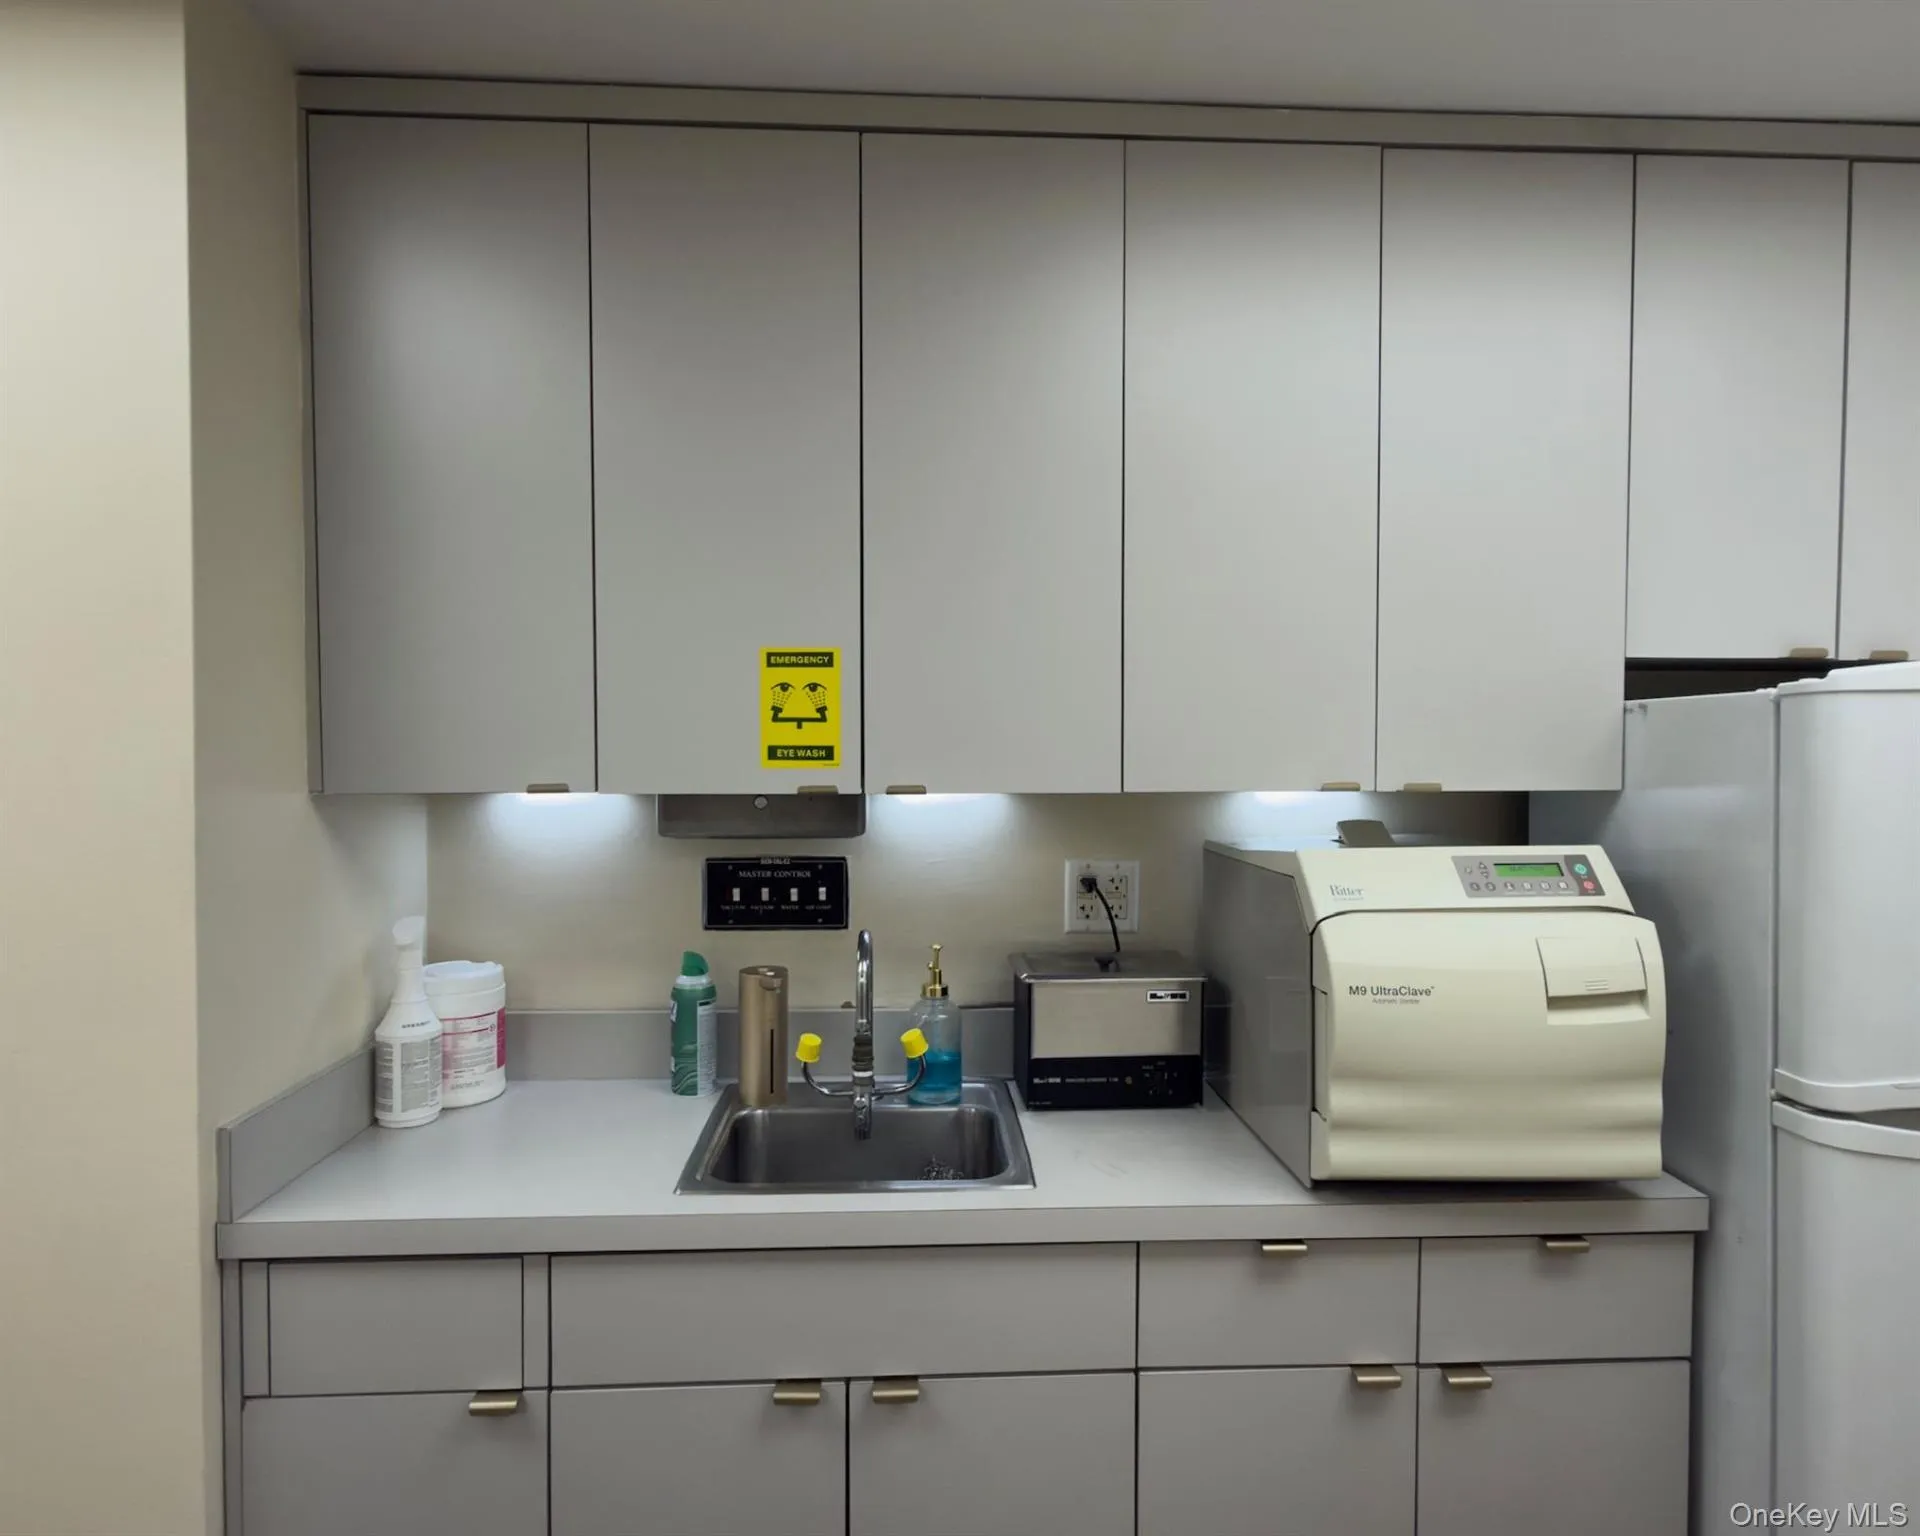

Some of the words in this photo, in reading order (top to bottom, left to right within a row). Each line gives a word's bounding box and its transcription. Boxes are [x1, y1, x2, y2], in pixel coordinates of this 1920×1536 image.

[770, 655, 830, 664] EMERGENCY
[776, 749, 795, 757] EYE
[797, 749, 826, 757] WASH
[739, 870, 772, 878] MASTER
[773, 870, 812, 878] CONTROL
[1348, 985, 1367, 996] M9
